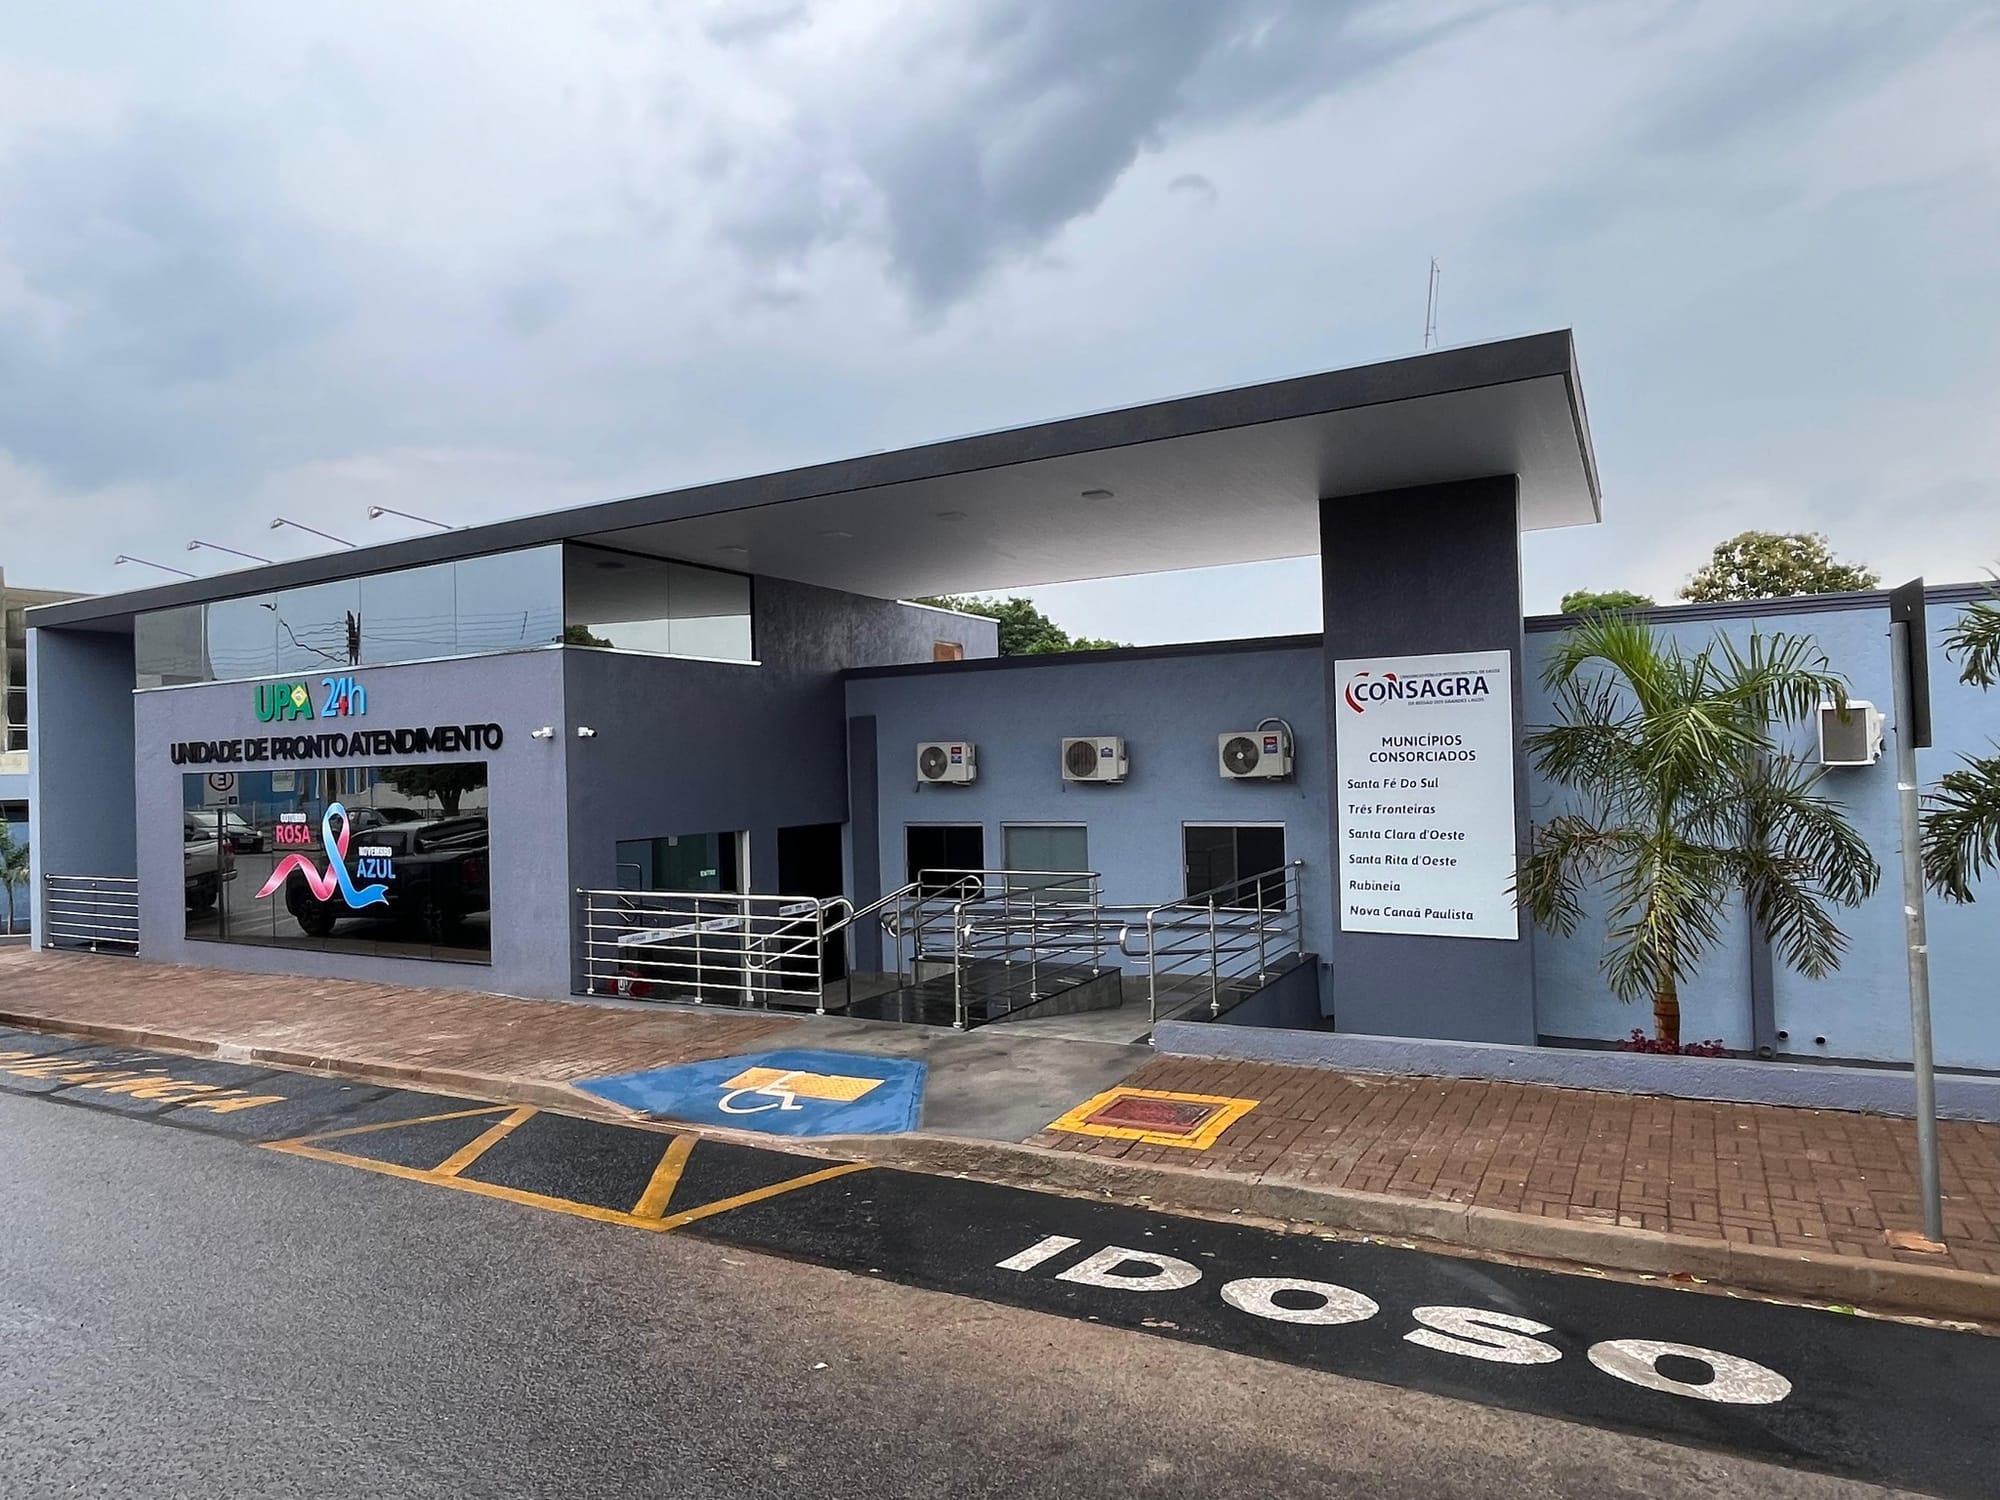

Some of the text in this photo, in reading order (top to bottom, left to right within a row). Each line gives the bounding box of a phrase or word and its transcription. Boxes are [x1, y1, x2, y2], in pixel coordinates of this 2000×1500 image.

[1354, 675, 1489, 702] CONSAGRA
[254, 677, 367, 722] UPA 24h
[170, 723, 503, 765] UNIDADE DE PRONTO ATENDIMENTO
[1381, 732, 1462, 747] MUNICÍPIOS
[1369, 750, 1476, 763] CONSORCIADOS
[1347, 777, 1439, 789] Santa Fé Do Sul
[1348, 803, 1436, 814] Três Fronteiras
[275, 824, 311, 843] ROSA
[1348, 828, 1465, 841] Santa Clara d'Oeste
[1349, 854, 1457, 867] Santa Rita d'Oeste
[356, 858, 396, 879] AZUL
[1349, 880, 1401, 892] Rubineia
[1350, 905, 1474, 920] Nova Canaã Paulista
[995, 1234, 1793, 1405] IDOSO
